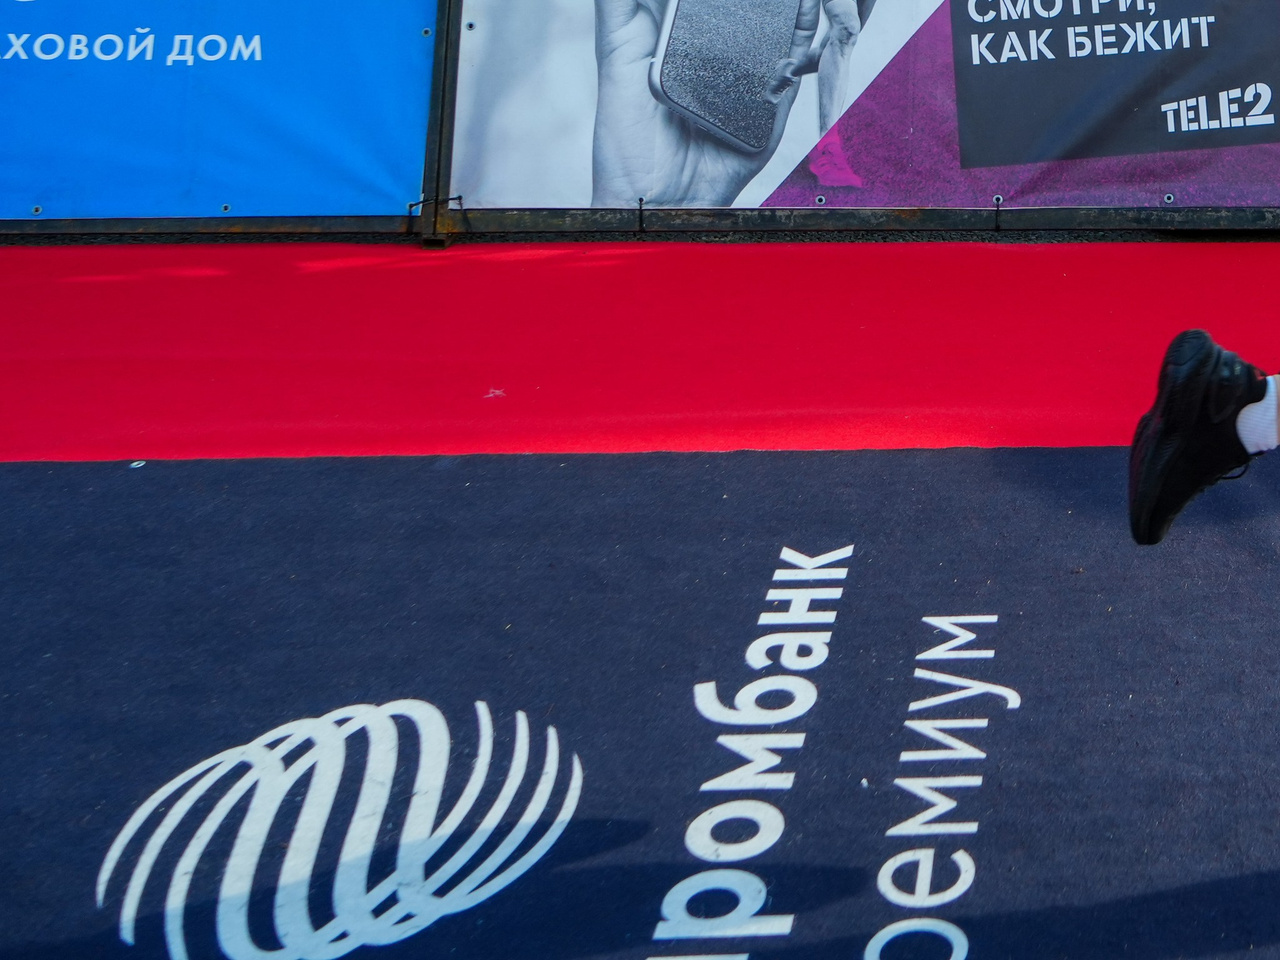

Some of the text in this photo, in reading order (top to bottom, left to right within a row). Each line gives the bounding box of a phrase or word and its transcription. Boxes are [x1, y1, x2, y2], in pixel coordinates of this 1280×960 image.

[0, 27, 262, 66] ХОВОЙ ДОМ
[970, 15, 1216, 65] КАК БЕЖИТ
[1160, 82, 1275, 133] TELE2
[645, 544, 855, 960] ромбанк
